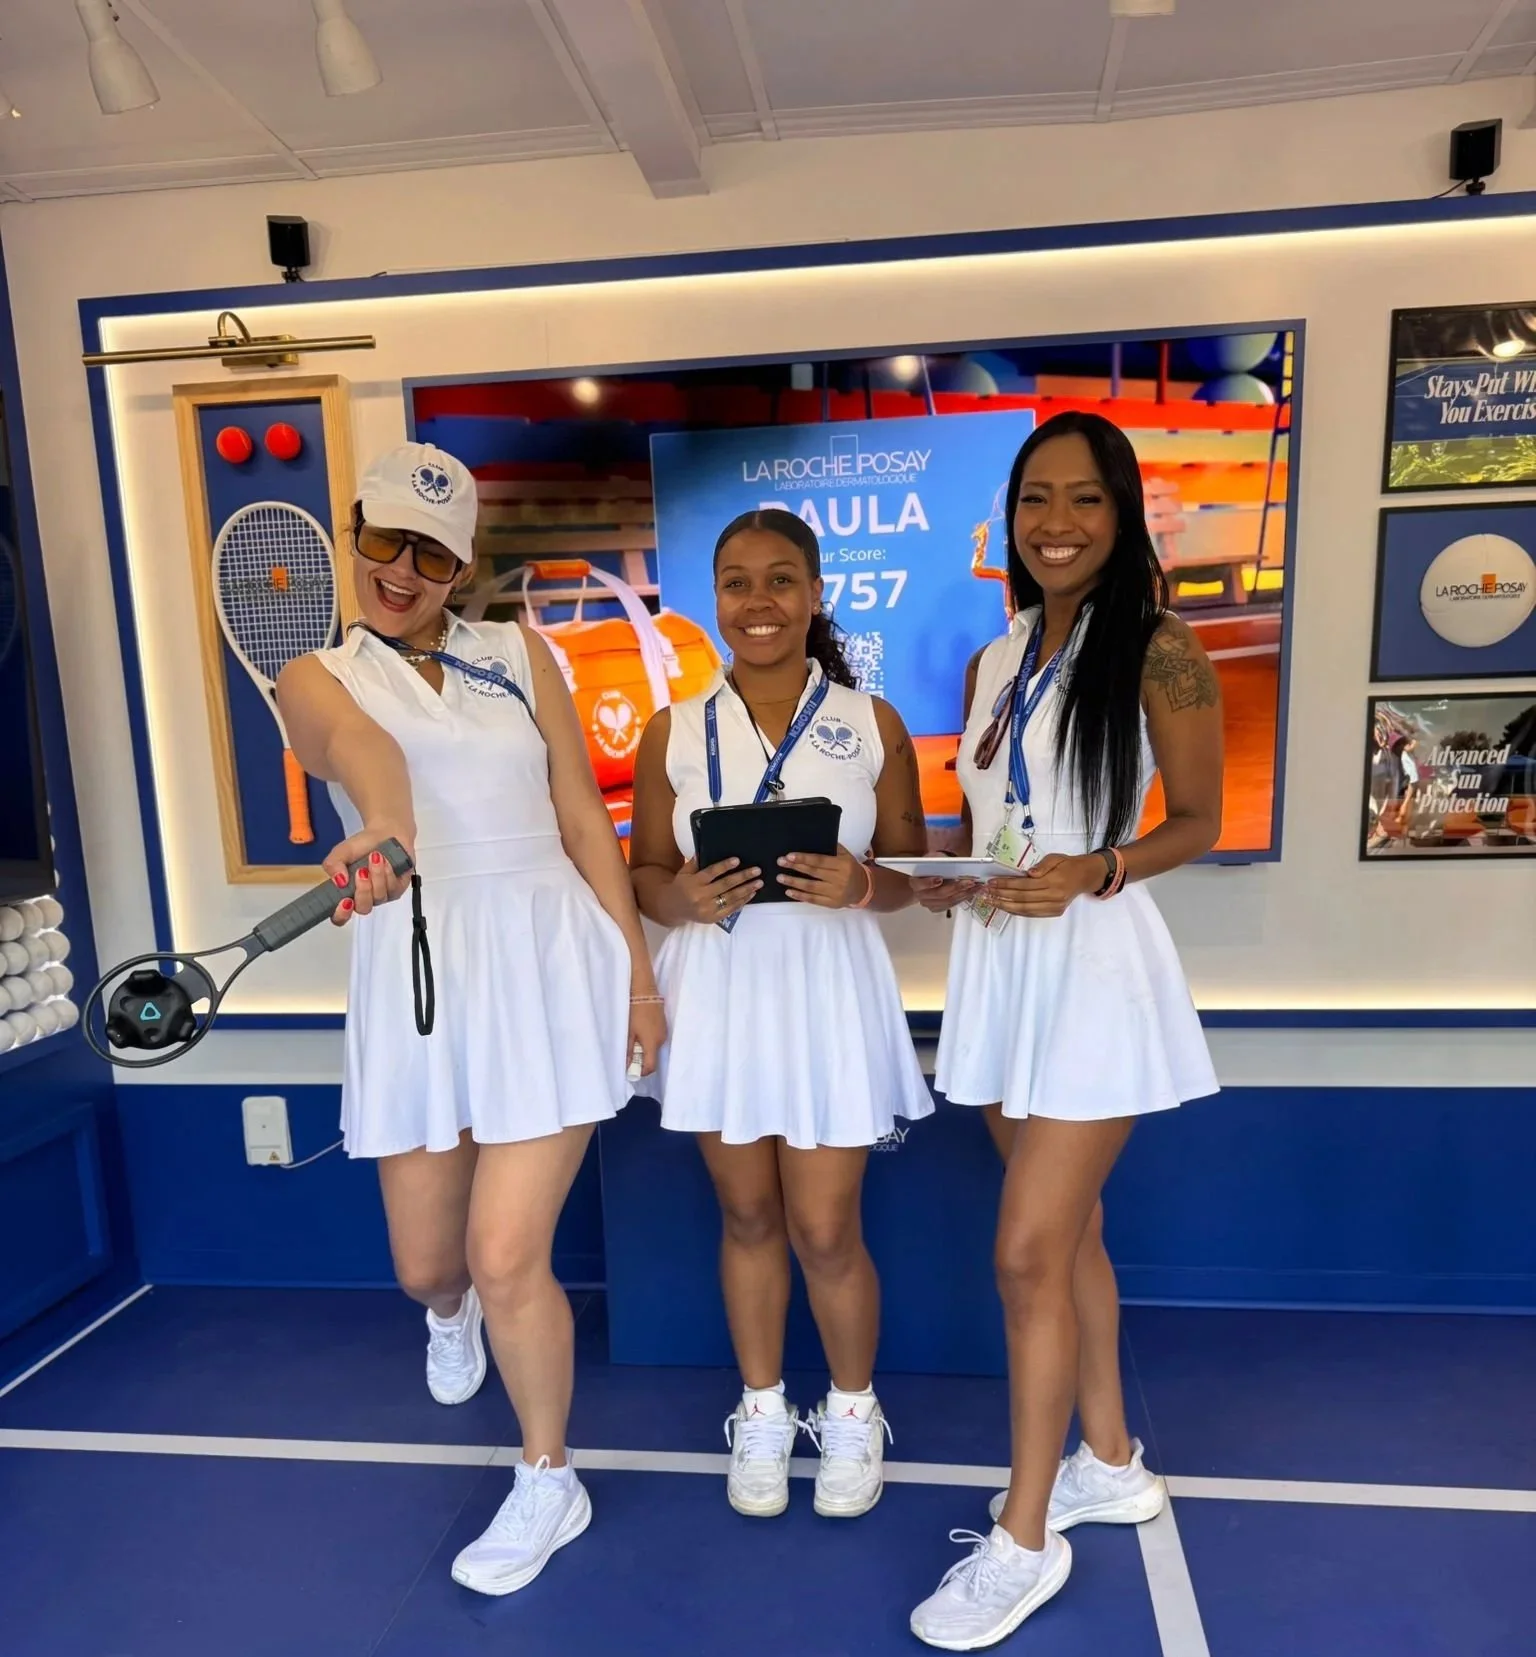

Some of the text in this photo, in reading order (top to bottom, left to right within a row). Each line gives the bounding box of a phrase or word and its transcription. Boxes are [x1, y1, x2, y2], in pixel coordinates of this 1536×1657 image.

[1424, 374, 1474, 407] Stays
[1473, 371, 1509, 397] Put
[1440, 401, 1470, 424] You
[743, 449, 932, 482] LA ROCHE POSAY
[759, 492, 930, 537] AULA
[821, 548, 886, 564] ur Score:
[1435, 581, 1528, 597] LA ROCHE POSAY
[821, 715, 841, 723] CLUB
[811, 740, 820, 750] LA
[1424, 744, 1512, 767] Advanced
[1448, 768, 1482, 790] Sun
[1418, 792, 1509, 814] Protection
